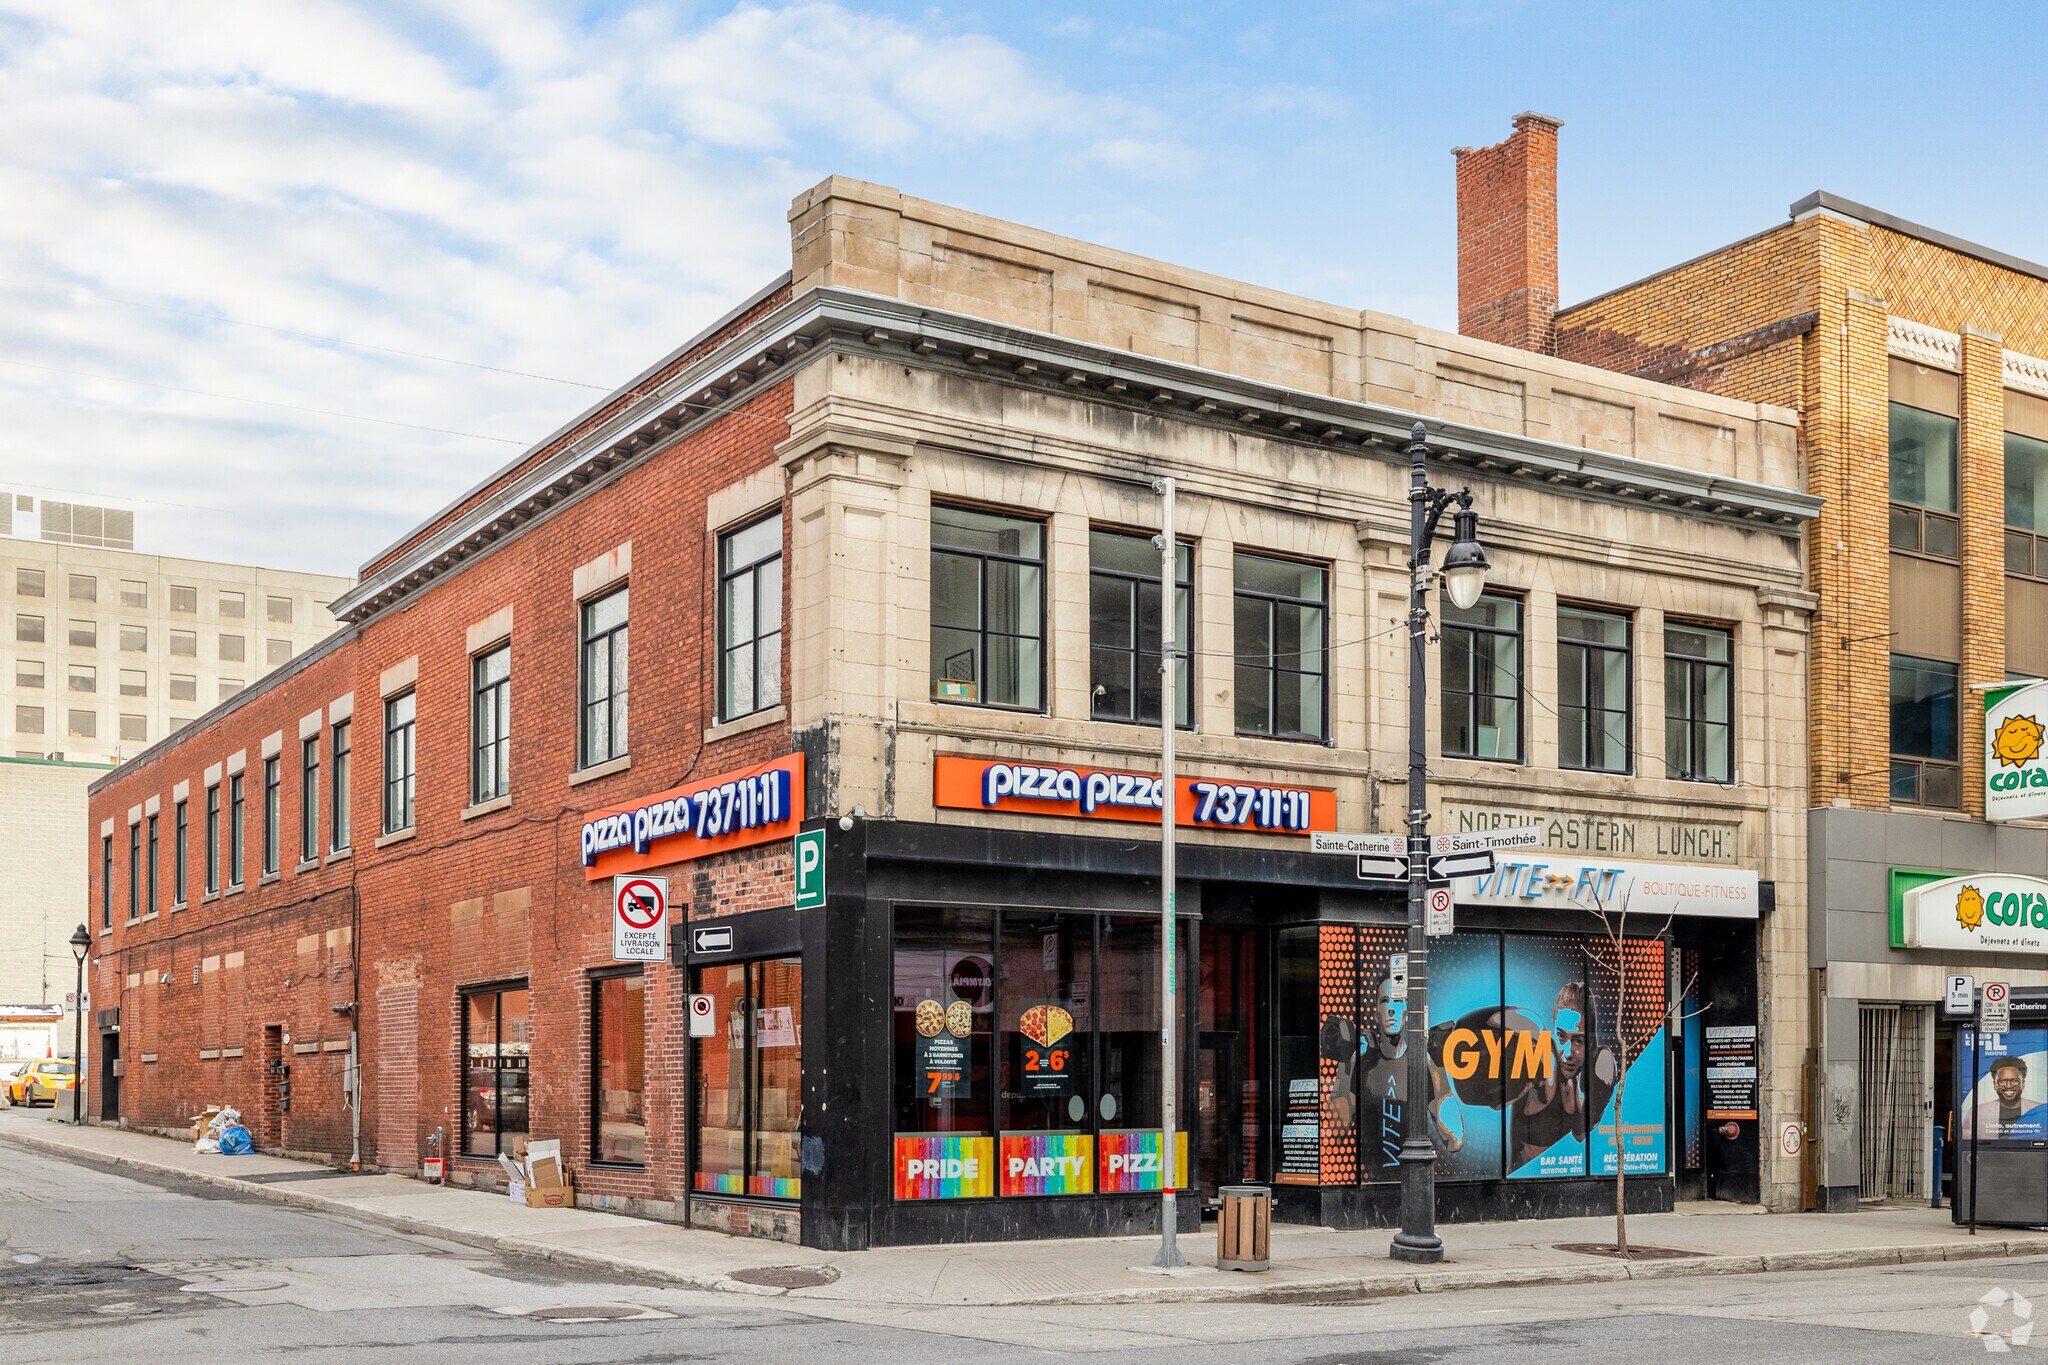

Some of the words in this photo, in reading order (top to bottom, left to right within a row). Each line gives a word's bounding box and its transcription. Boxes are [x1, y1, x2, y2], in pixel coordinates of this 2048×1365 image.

[982, 763, 1081, 806] pizza
[1990, 767, 2048, 791] cora
[581, 812, 632, 866] pizza
[634, 796, 690, 854] pizza
[1315, 839, 1390, 852] Sainte-Catherine
[1452, 833, 1537, 851] Saint-Timothée
[1657, 826, 1722, 858] LUNCH
[800, 840, 819, 889] P
[1477, 862, 1549, 897] VITE
[1575, 867, 1625, 900] FIT
[1643, 881, 1747, 900] BOUTIQUE-FITNESS
[1986, 891, 2048, 930] cora
[624, 932, 656, 940] EXCEPTÉ
[1981, 935, 2010, 946] Déjeuners
[2020, 938, 2040, 947] dîners
[626, 947, 654, 955] LOCALE
[1955, 978, 1965, 991] P
[1708, 1028, 1729, 1037] VITE
[1738, 1027, 1754, 1036] FIT
[1443, 1028, 1552, 1080] GYM
[1708, 1069, 1723, 1077] BAR
[1291, 1080, 1312, 1090] VITE
[1283, 1127, 1297, 1136] BAR
[1633, 1136, 1653, 1146] BOXE
[1540, 1156, 1556, 1166] BAR
[1558, 1153, 1583, 1165] SANTÉ
[1604, 1152, 1658, 1163] RÉCPÉRATION
[908, 1159, 979, 1180] PRIDE
[1009, 1156, 1085, 1178] PARTY
[1570, 1165, 1583, 1173] KÉTO
